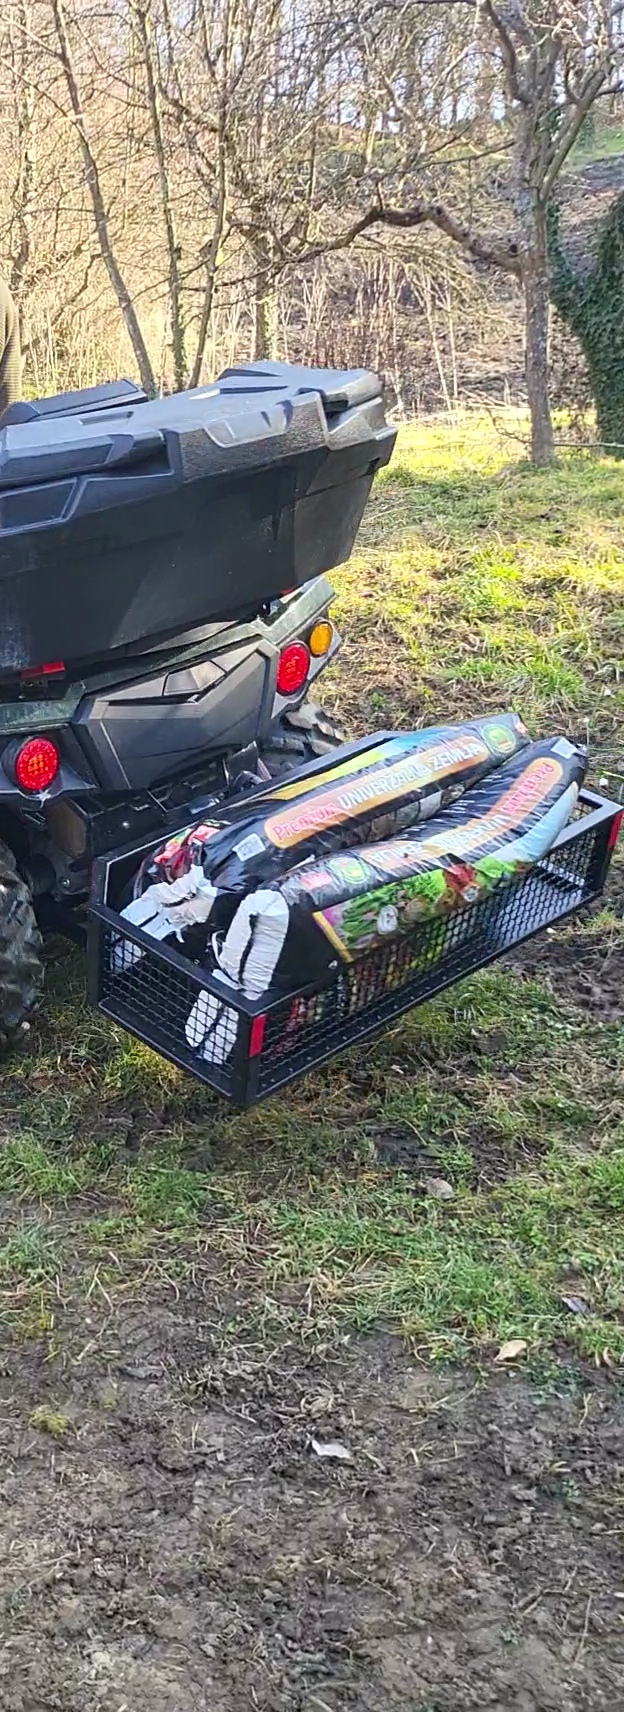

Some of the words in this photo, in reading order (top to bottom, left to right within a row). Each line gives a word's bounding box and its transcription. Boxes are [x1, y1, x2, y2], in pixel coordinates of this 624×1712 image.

[272, 803, 338, 841] Premium
[338, 763, 433, 809] UNIVERZALNA
[431, 742, 484, 771] ZEMLJA
